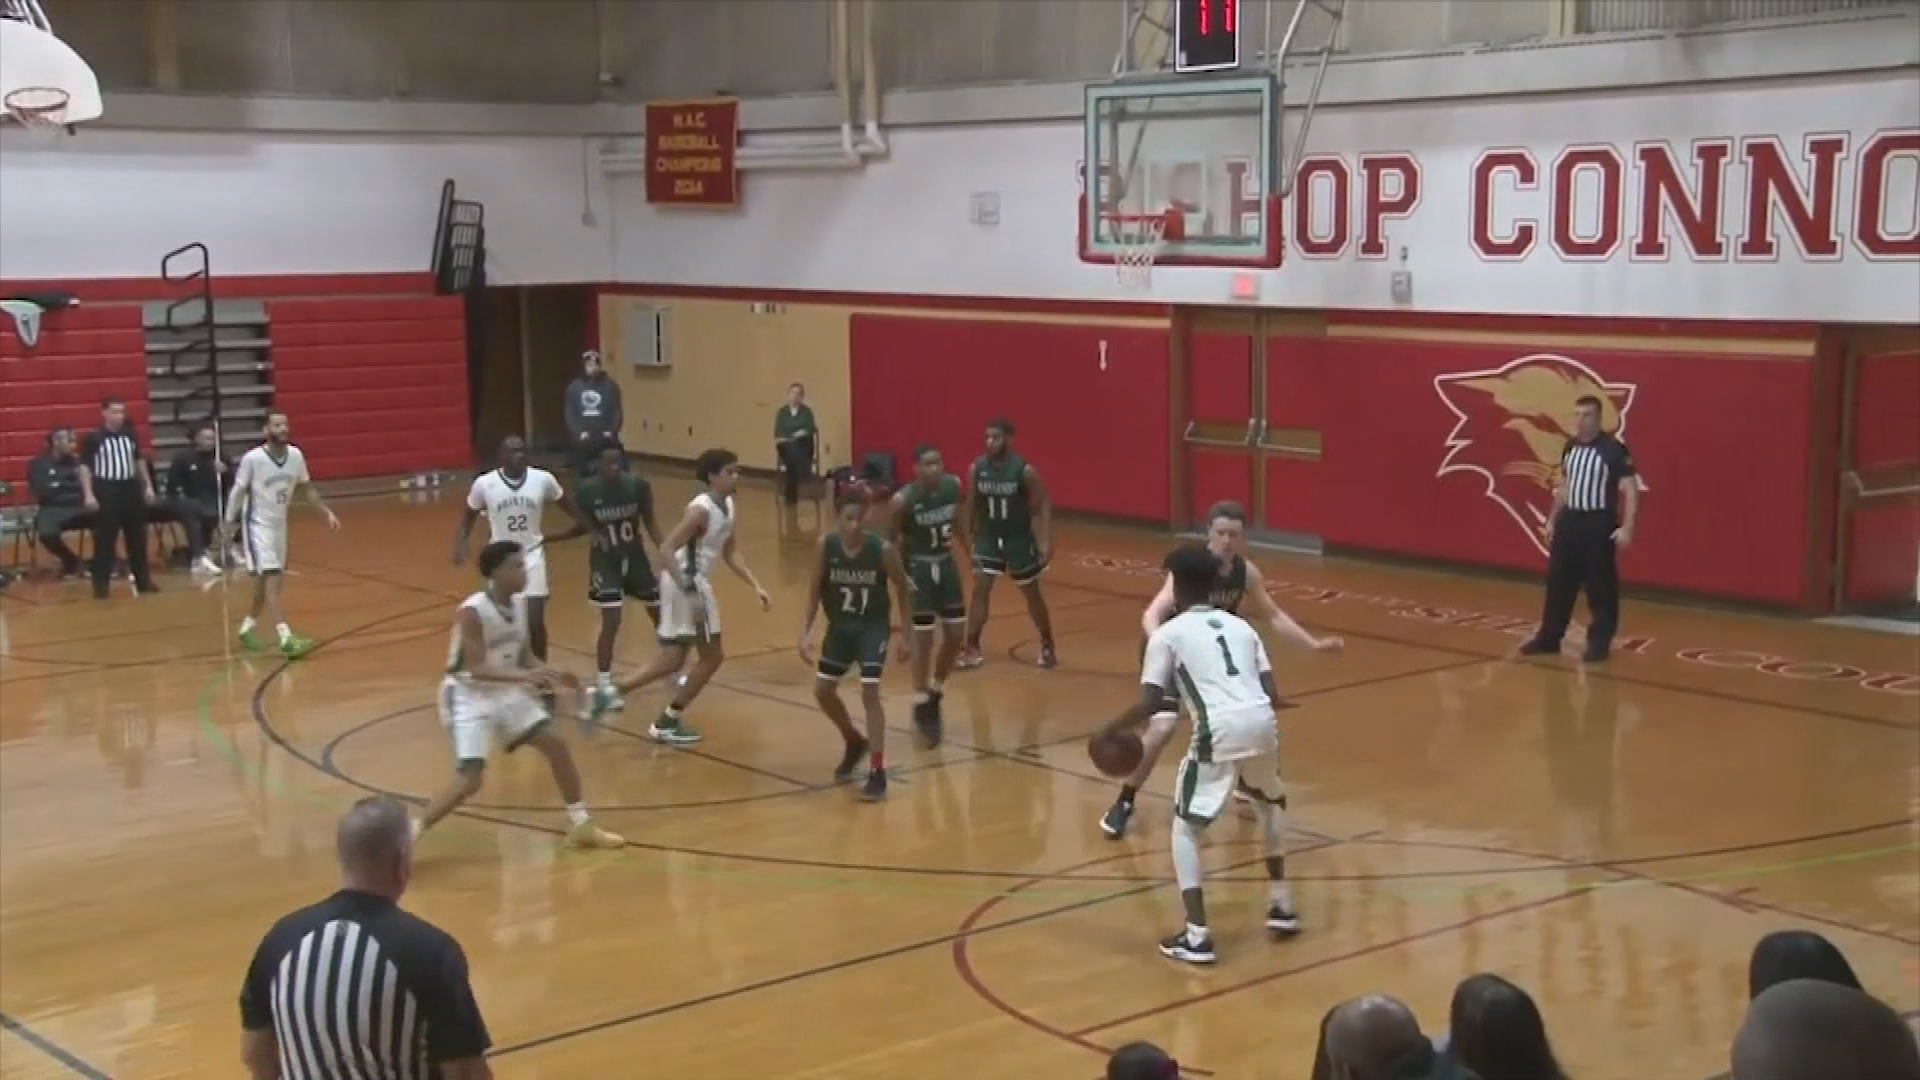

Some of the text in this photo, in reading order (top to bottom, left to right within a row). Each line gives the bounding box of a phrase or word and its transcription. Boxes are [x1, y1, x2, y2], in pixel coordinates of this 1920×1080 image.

[658, 134, 721, 150] BASEBALL
[656, 156, 722, 173] CHAMPIONS
[1469, 128, 1920, 262] CONNO
[988, 496, 1008, 519] 11
[507, 513, 528, 532] 22
[607, 520, 634, 547] 10
[839, 586, 869, 615] 21
[1216, 635, 1241, 676] 1
